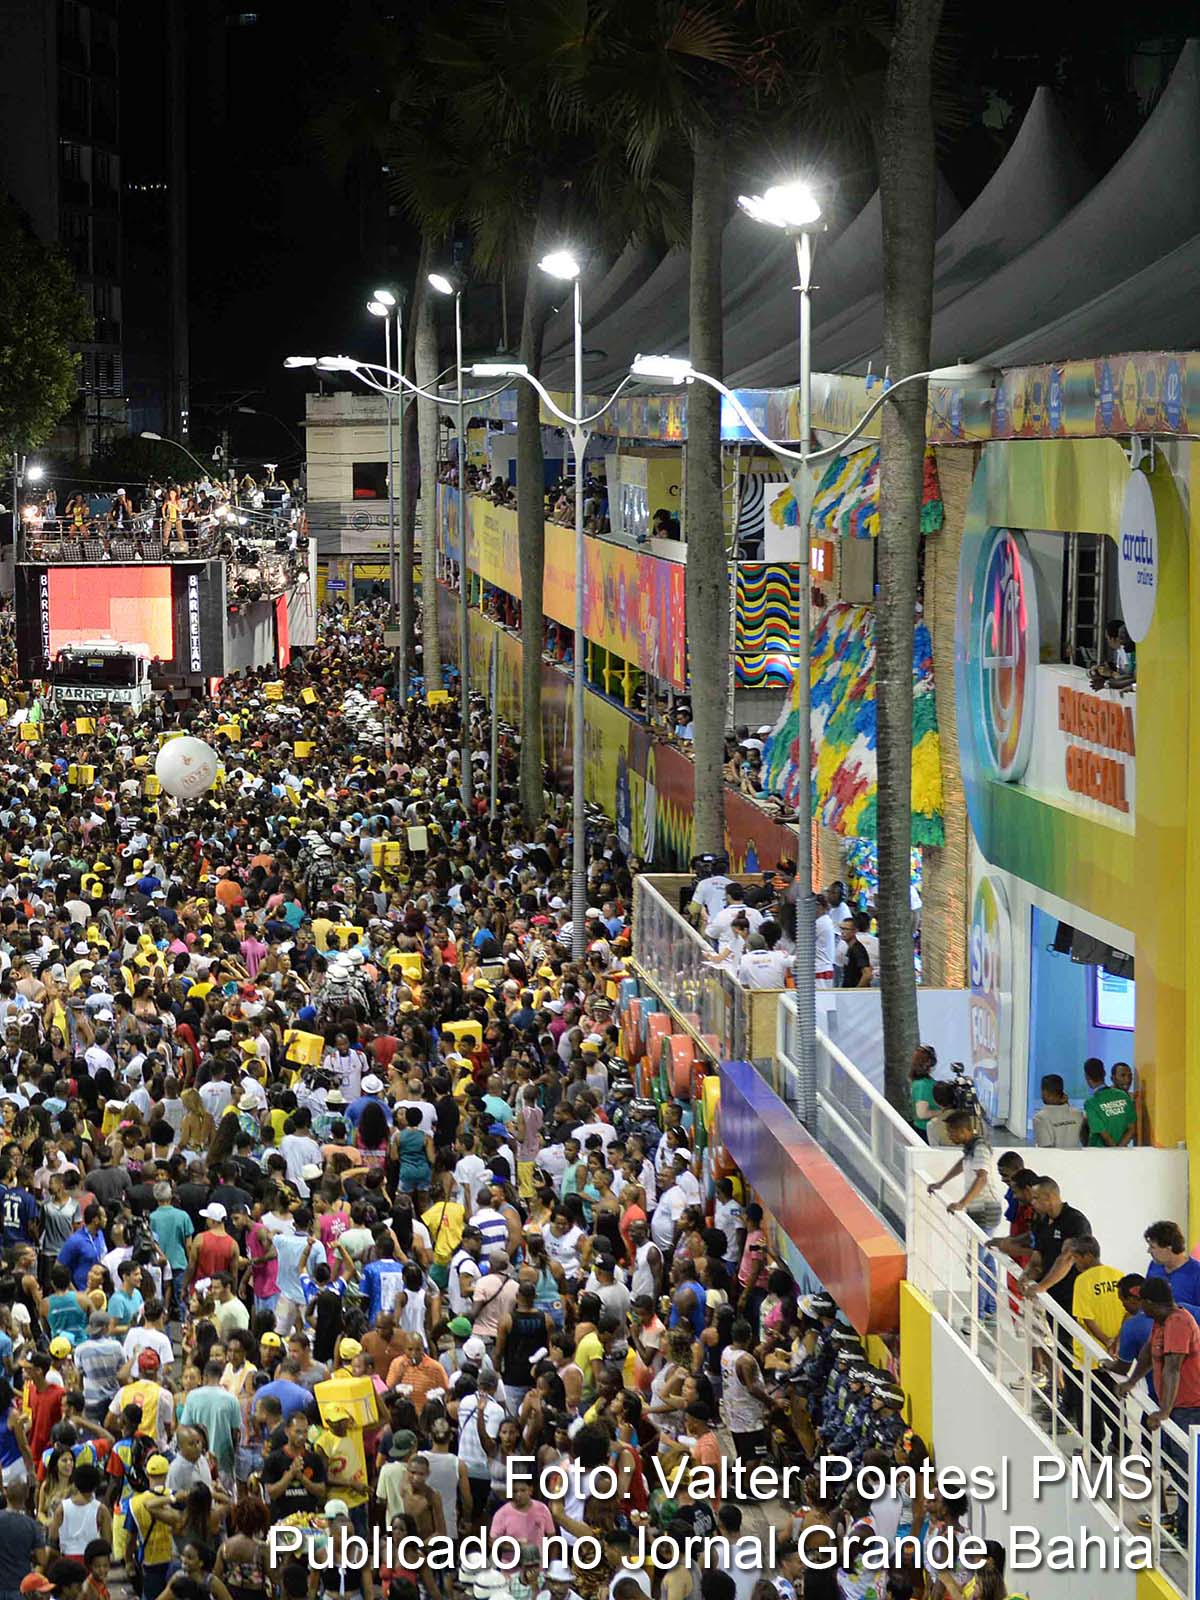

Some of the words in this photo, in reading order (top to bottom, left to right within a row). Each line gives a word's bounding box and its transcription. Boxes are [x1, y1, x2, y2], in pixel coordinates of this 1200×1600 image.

[1123, 529, 1153, 565] aratu
[189, 574, 202, 672] BARRETÃO
[1058, 686, 1136, 757] EMISSORA
[1066, 745, 1130, 813] OFICIAL
[4, 1201, 20, 1223] 11
[1094, 1280, 1118, 1296] STAF
